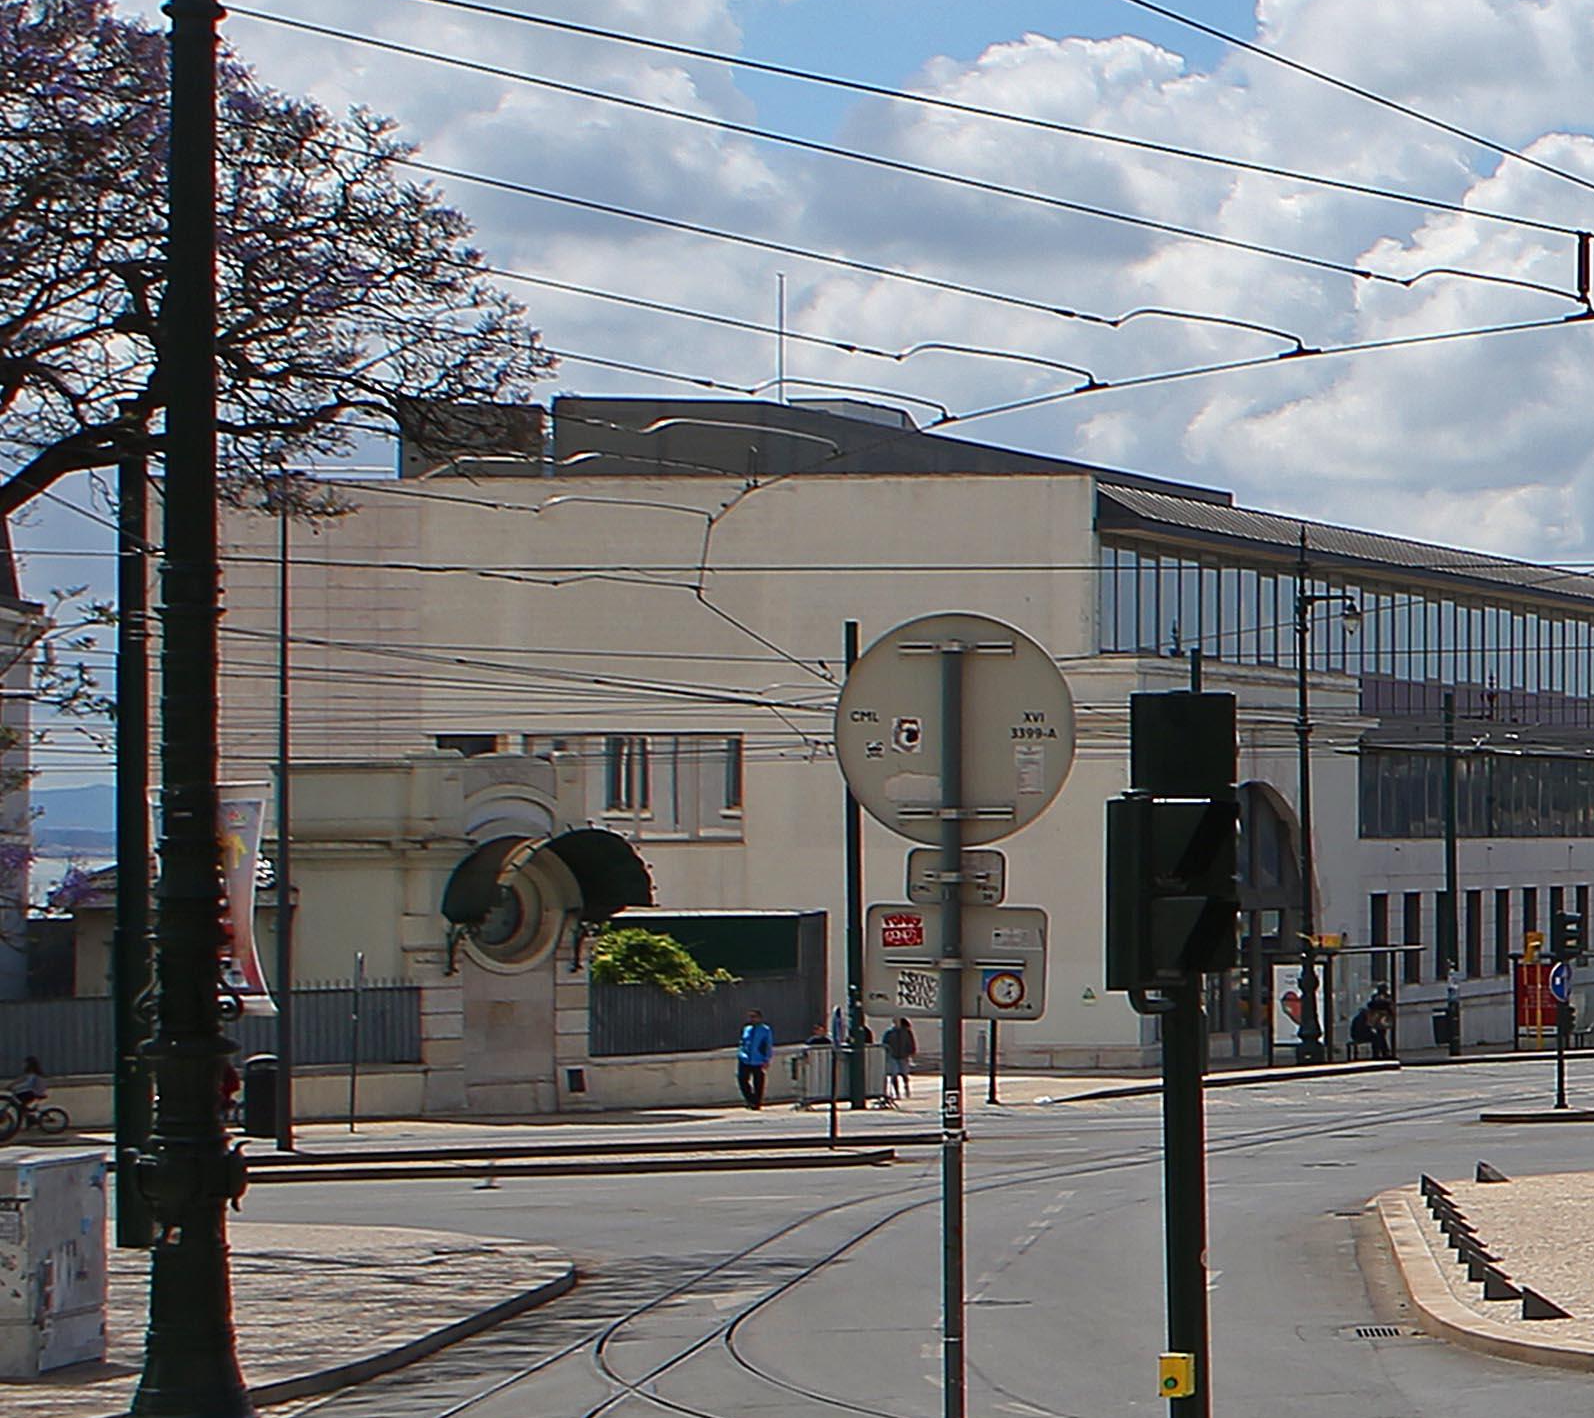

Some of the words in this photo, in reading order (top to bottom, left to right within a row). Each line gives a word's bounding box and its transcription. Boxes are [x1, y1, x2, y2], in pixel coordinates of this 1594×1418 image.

[850, 710, 880, 723] CML
[1023, 712, 1046, 724] XVI
[1010, 727, 1058, 740] 3399-A
